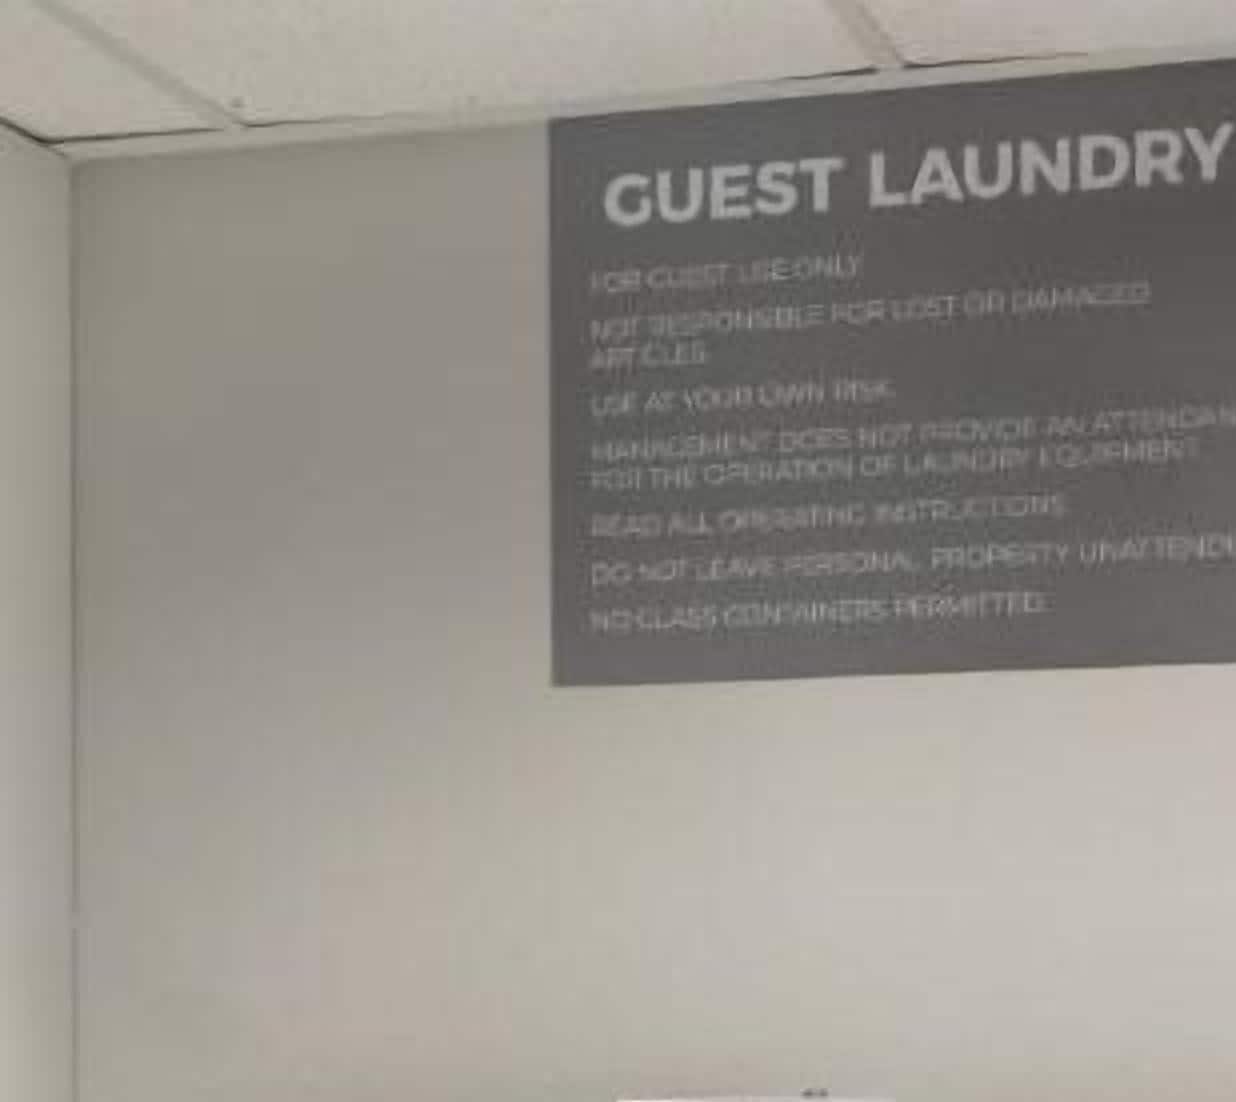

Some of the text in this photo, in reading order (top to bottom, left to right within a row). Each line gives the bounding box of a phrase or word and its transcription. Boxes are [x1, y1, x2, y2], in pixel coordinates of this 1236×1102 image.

[604, 121, 1234, 226] GUEST LAUNDRY
[795, 254, 863, 280] ONLY
[893, 293, 955, 322] LOST
[963, 289, 1004, 319] OR
[1012, 280, 1150, 314] DAMAGED
[682, 384, 750, 411] YOUR
[758, 381, 825, 408] OWN
[779, 426, 850, 453] DOES
[857, 420, 912, 449] NOT
[648, 464, 697, 489] THE
[860, 453, 896, 478] OF
[904, 446, 1030, 476] LAUNDRY
[591, 561, 631, 586] DO
[932, 542, 1068, 571] PROPERTY
